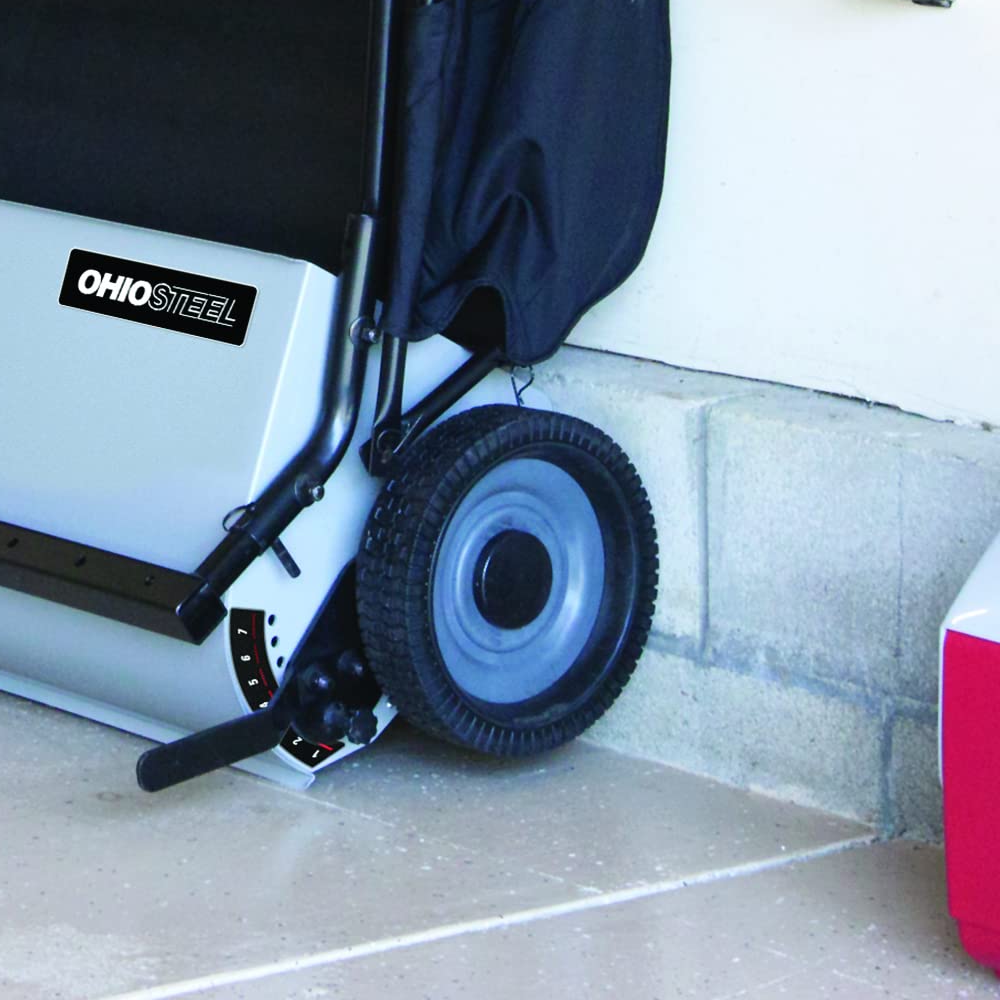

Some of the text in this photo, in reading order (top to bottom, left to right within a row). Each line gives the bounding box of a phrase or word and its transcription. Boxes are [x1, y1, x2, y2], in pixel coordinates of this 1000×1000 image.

[240, 654, 251, 662] 6
[248, 678, 259, 687] 5
[292, 736, 303, 746] 2
[311, 749, 320, 758] 1
